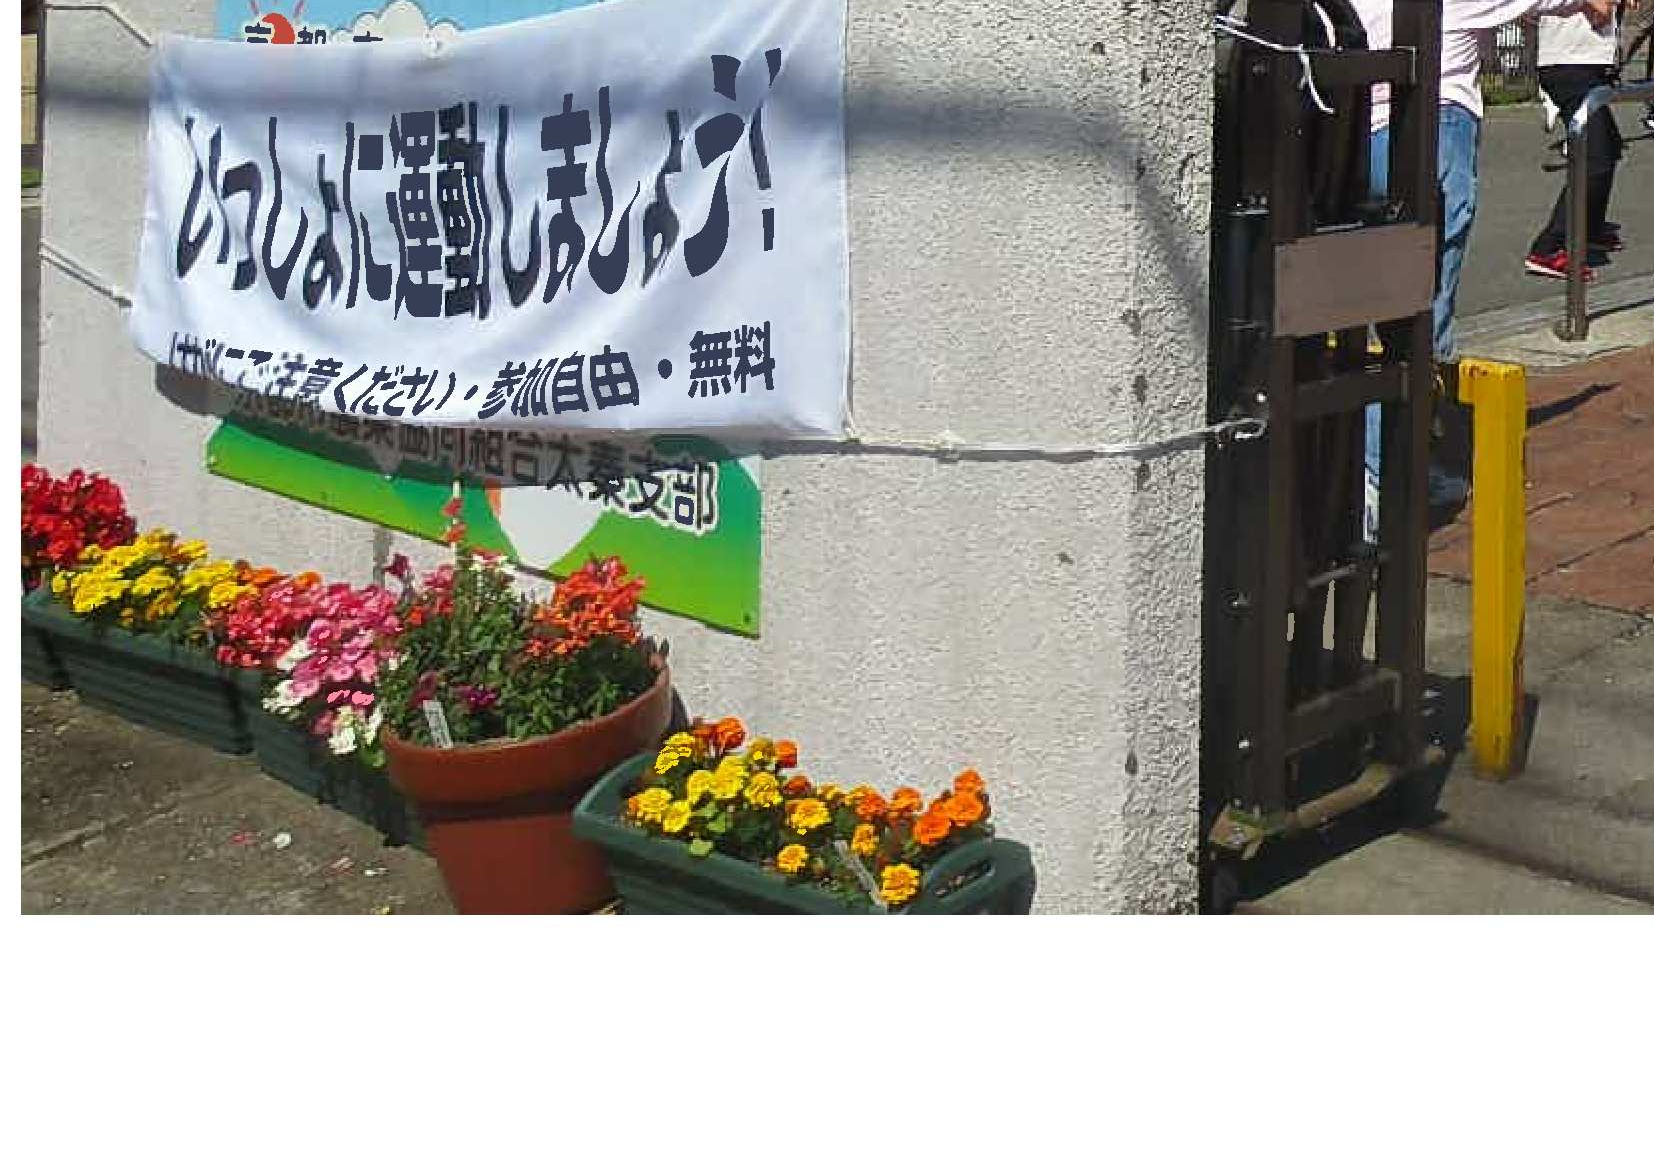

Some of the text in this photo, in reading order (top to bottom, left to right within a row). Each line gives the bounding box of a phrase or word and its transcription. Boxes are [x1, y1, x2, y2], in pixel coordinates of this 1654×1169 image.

[176, 47, 781, 320] いっしょに運動しましょう!
